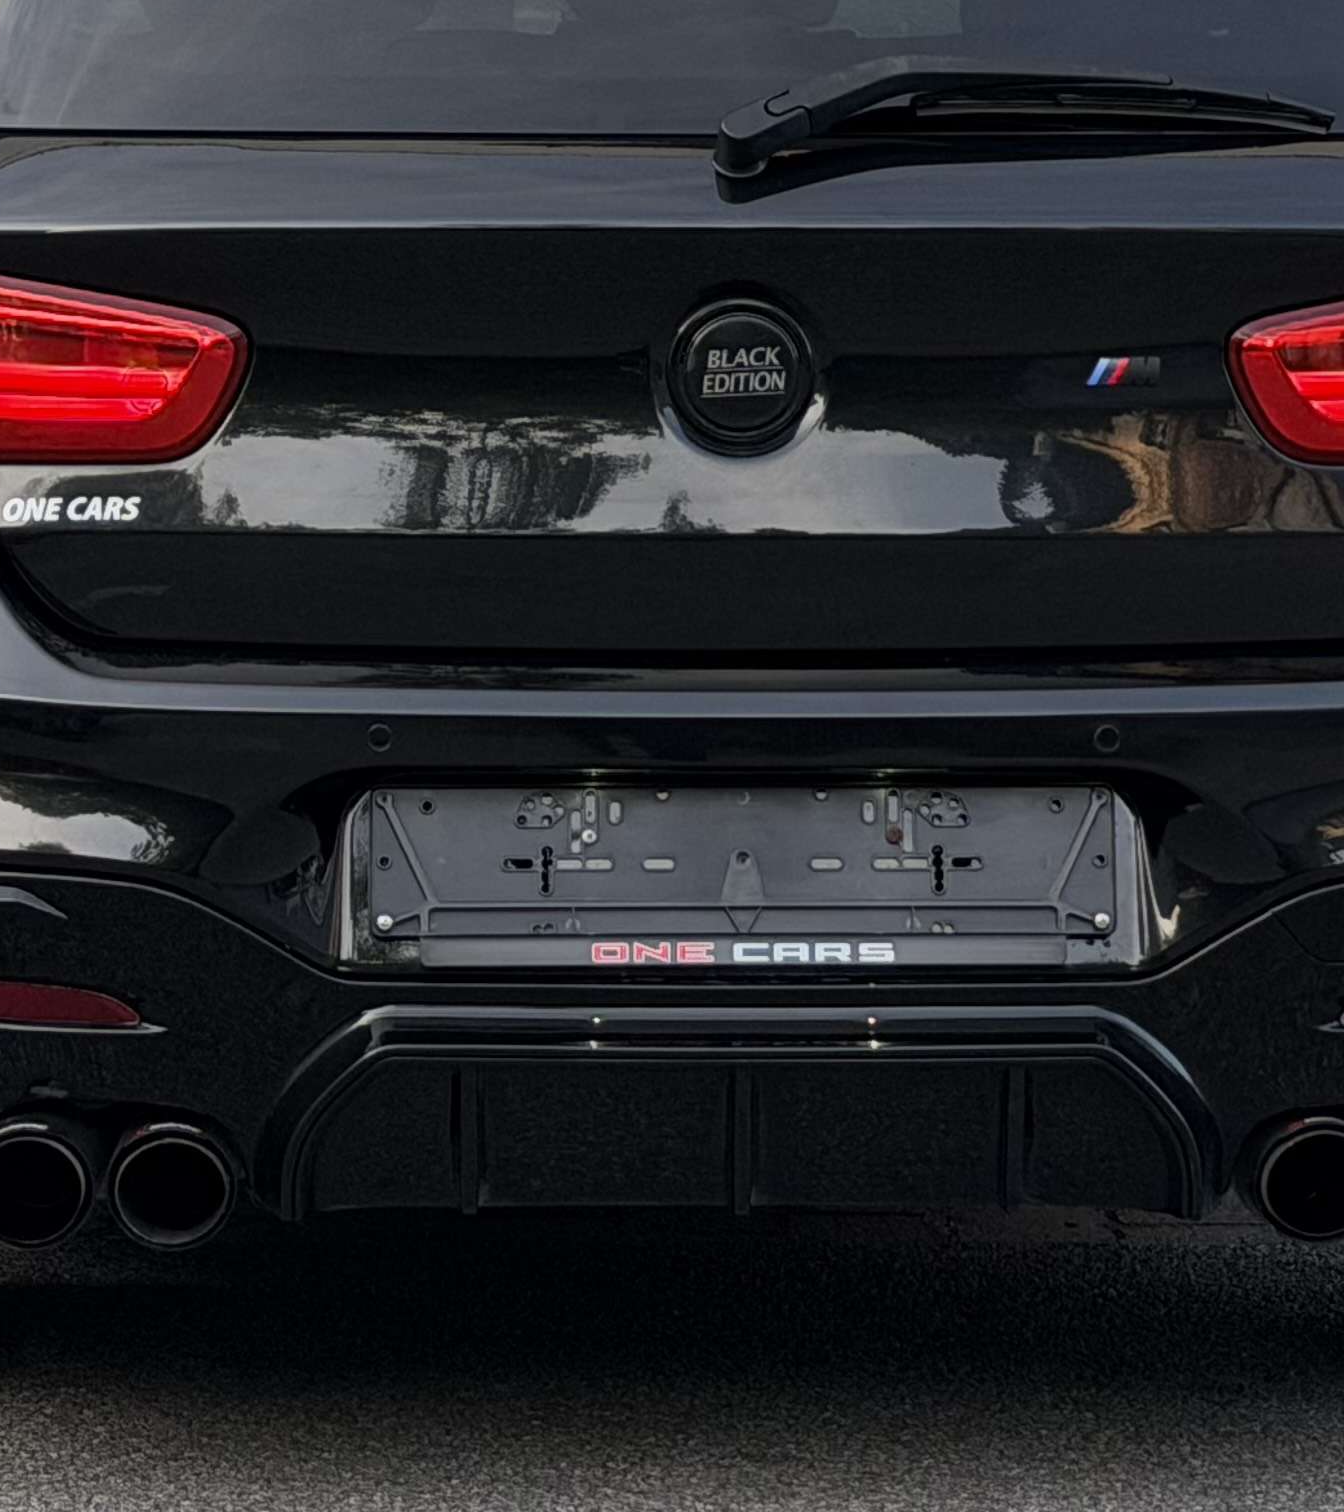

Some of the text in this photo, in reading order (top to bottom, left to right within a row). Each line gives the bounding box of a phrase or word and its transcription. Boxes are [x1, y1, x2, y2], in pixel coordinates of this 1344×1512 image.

[706, 346, 781, 369] BLACK
[702, 370, 787, 394] EDITION
[2, 496, 142, 522] ONE CARS
[591, 941, 896, 964] ONE CARS
